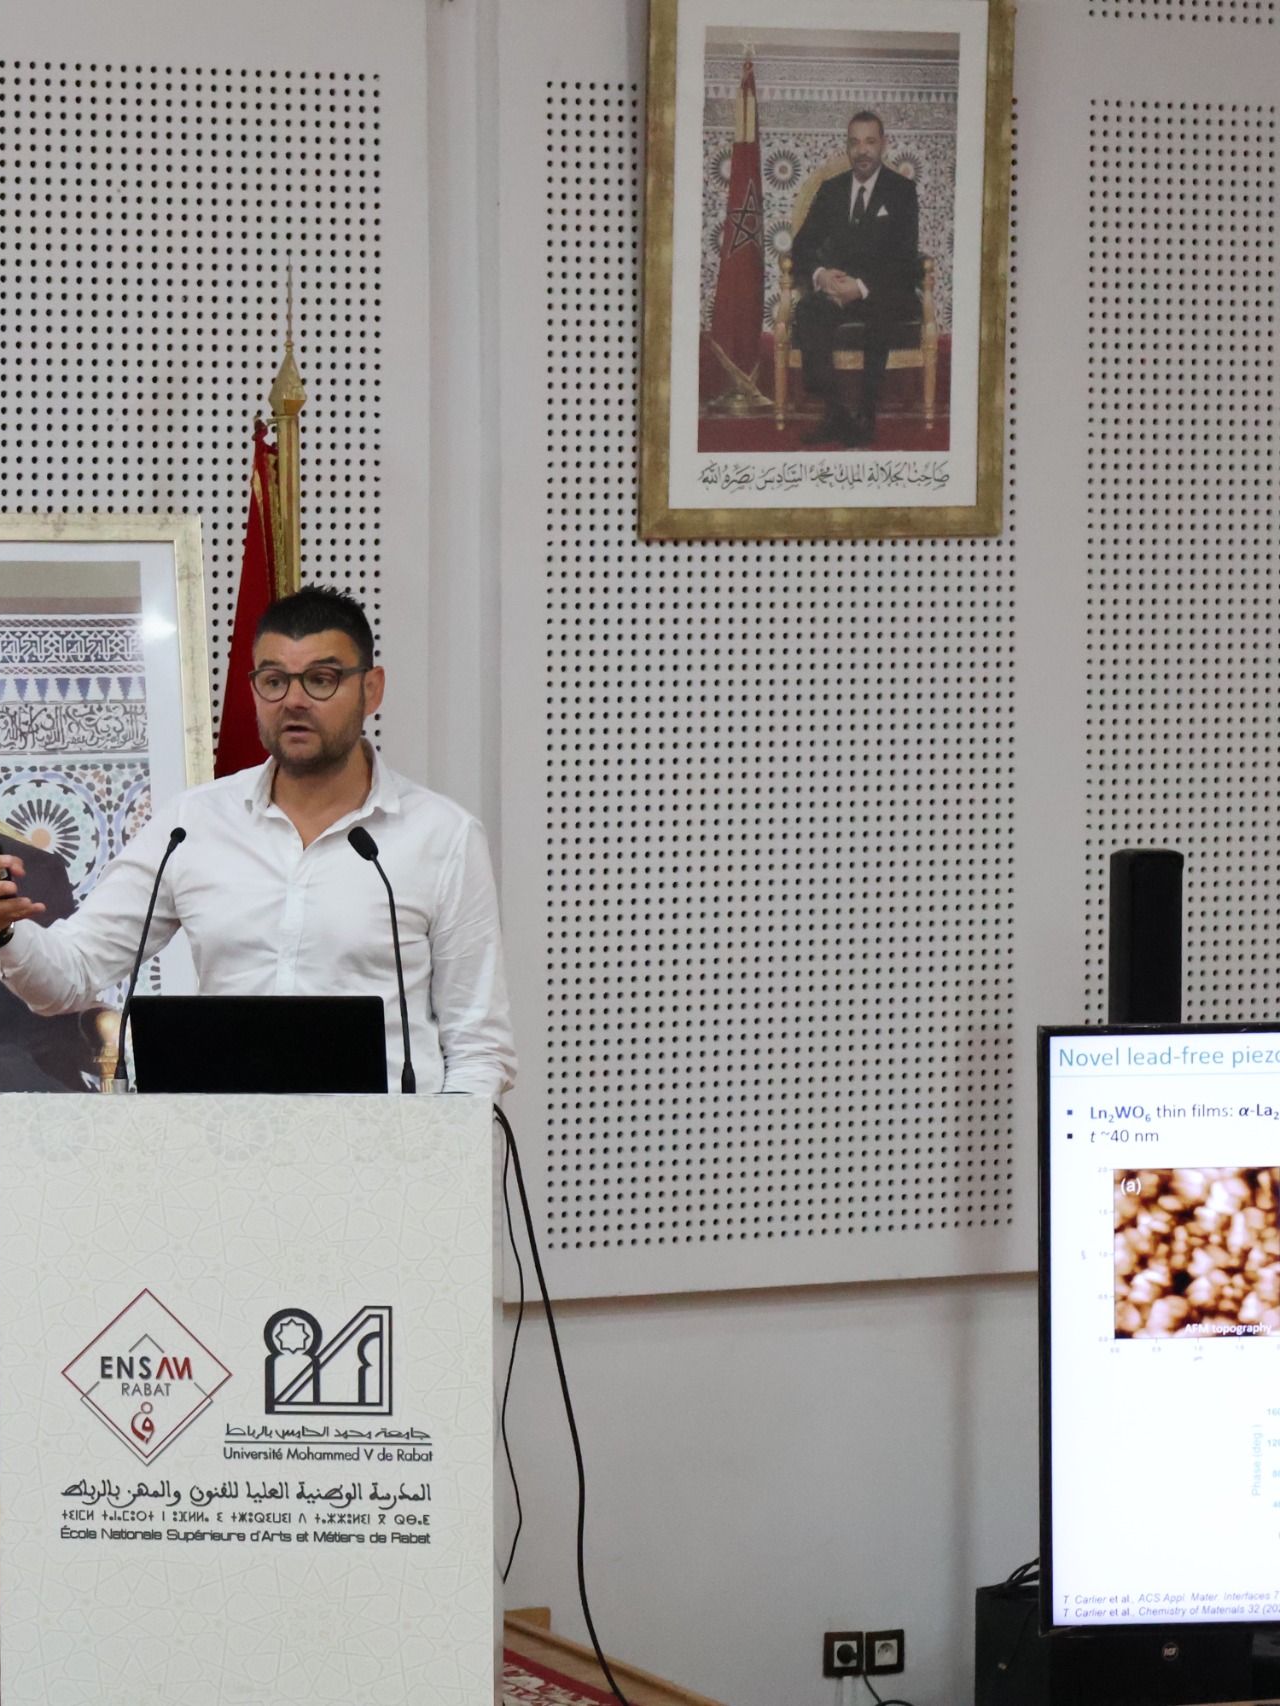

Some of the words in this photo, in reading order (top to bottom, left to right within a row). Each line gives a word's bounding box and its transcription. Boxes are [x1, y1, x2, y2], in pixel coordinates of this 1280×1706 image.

[1059, 1047, 1120, 1067] Novel
[1127, 1046, 1224, 1066] lead-free
[1156, 1104, 1186, 1119] thin
[1192, 1103, 1233, 1118] films:
[1135, 1131, 1159, 1143] nm
[1120, 1178, 1142, 1195] (a)
[1185, 1323, 1209, 1334] AFM
[1211, 1321, 1272, 1337] topography
[100, 1356, 193, 1380] ENSAM
[121, 1382, 172, 1397] RABAT
[223, 1446, 283, 1461] Université
[287, 1446, 360, 1462] Mohammed
[363, 1448, 374, 1461] V
[377, 1447, 393, 1462] de
[397, 1447, 433, 1462] Rabat
[61, 1478, 121, 1505] بالرباط
[107, 1480, 181, 1508] والمهن
[190, 1480, 238, 1507] للفنون
[246, 1481, 289, 1503] العليا
[296, 1481, 362, 1508] الوطنية
[369, 1481, 431, 1510] المدرسة
[60, 1525, 97, 1540] École
[101, 1528, 162, 1541] Nationale
[166, 1528, 246, 1543] Supérieure
[250, 1530, 292, 1543] d'Arts
[296, 1531, 309, 1543] et
[313, 1530, 365, 1543] Métiers
[370, 1531, 387, 1543] de
[391, 1532, 431, 1544] Rabat
[1109, 1595, 1118, 1604] et
[1138, 1593, 1161, 1603] ACS
[1109, 1607, 1118, 1617] et
[1138, 1606, 1187, 1618] Chemistry
[1189, 1605, 1199, 1615] of
